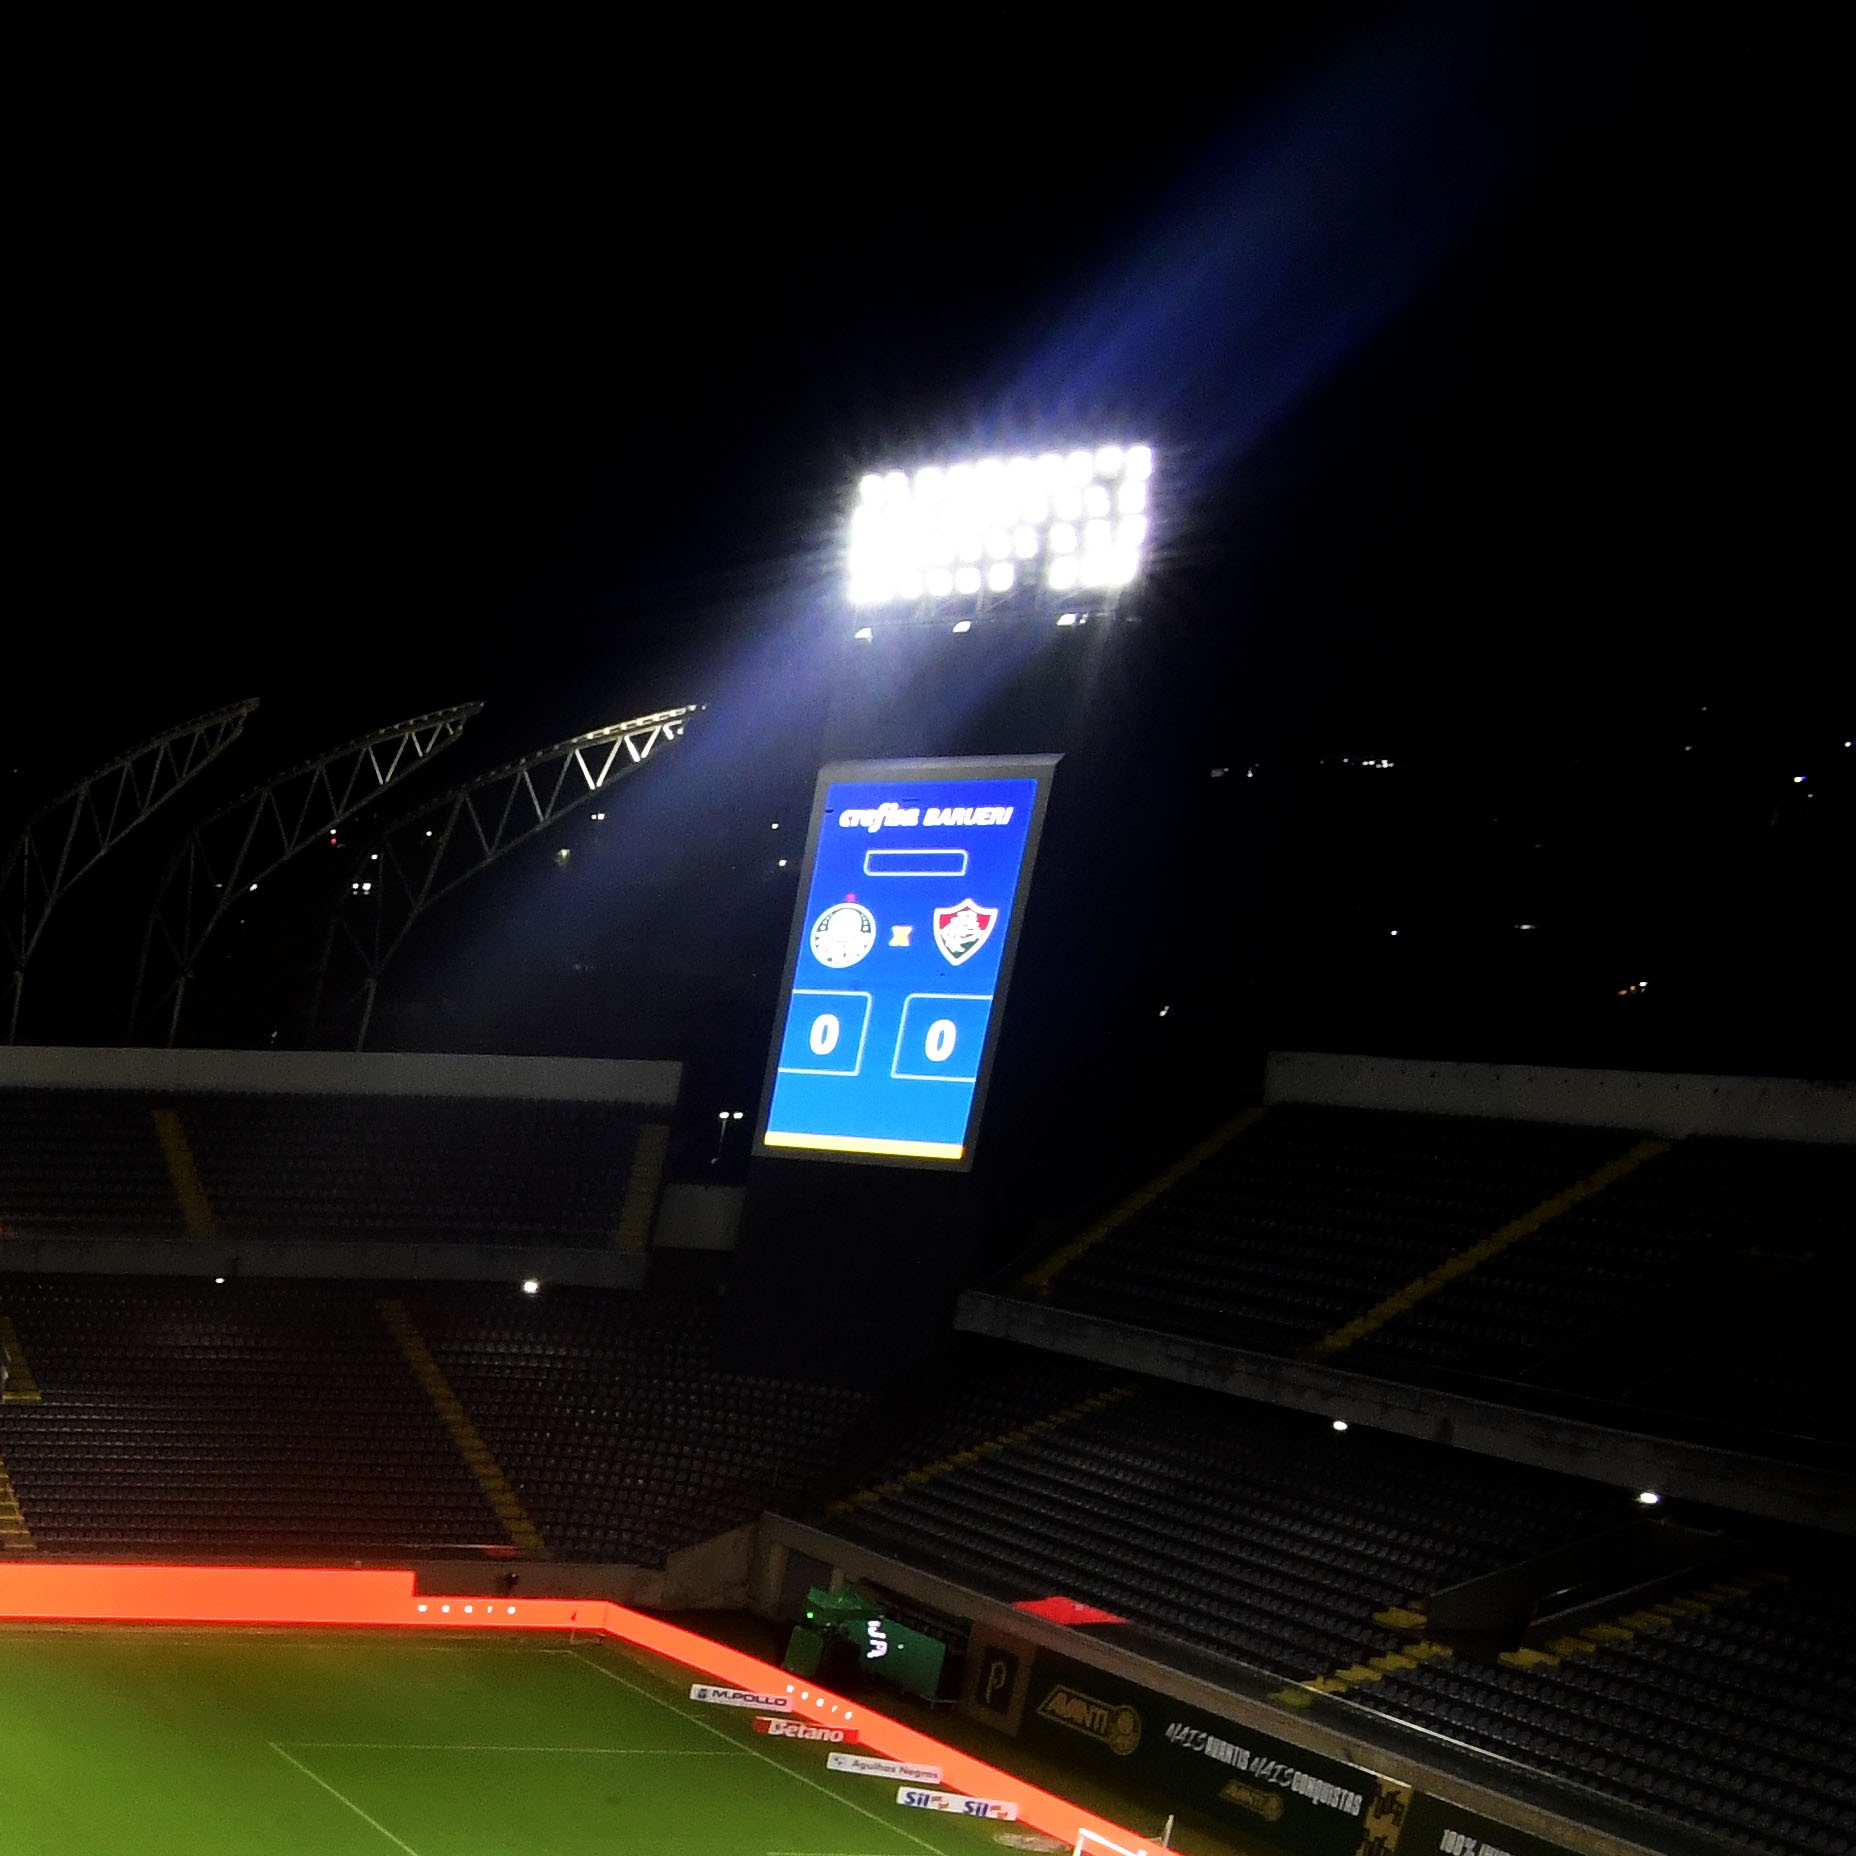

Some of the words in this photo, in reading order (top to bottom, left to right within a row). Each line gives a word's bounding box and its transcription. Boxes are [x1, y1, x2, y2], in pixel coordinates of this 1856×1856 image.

[923, 806, 1014, 827] BARUERI
[809, 1013, 840, 1055] 0
[924, 1019, 957, 1062] 0
[711, 1689, 788, 1707] M.POLLO
[768, 1719, 845, 1743] Betano
[904, 1791, 930, 1808] Sil
[963, 1800, 989, 1818] Sil
